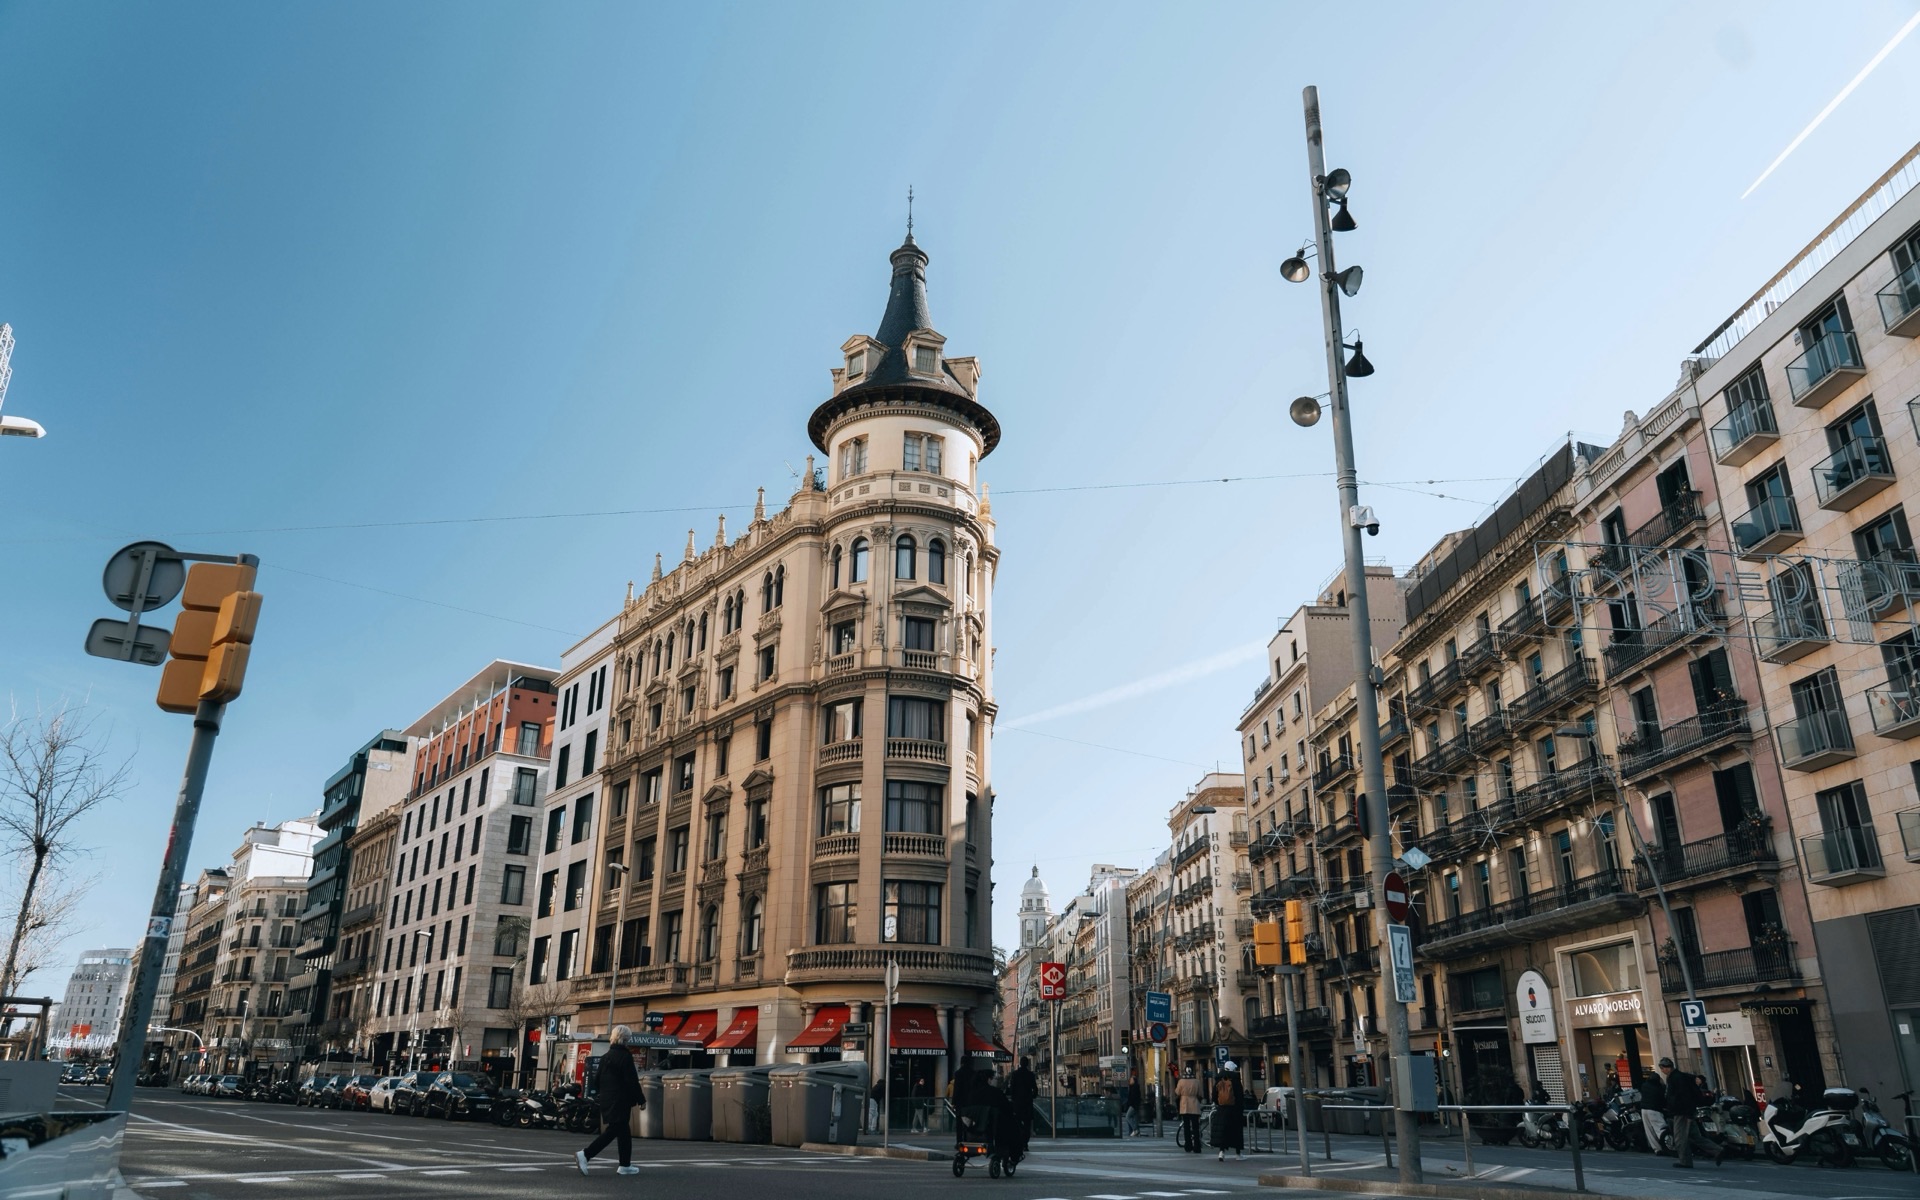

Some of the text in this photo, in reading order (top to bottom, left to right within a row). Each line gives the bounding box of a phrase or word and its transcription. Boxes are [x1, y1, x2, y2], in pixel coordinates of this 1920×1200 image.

[1211, 832, 1227, 988] HOTEL MIDMOST
[1050, 971, 1059, 980] M
[1575, 998, 1641, 1016] ALVARO MORENO
[1761, 1005, 1799, 1016] lemon
[1153, 1011, 1165, 1019] taxi
[1525, 1014, 1547, 1024] stucom
[1685, 1004, 1700, 1025] P
[549, 1018, 556, 1033] P
[1707, 1023, 1732, 1032] ORENCIA
[634, 1036, 676, 1046] VANGUARDIA
[901, 1048, 917, 1056] SALON
[917, 1048, 947, 1056] RECREATIVO
[1218, 1047, 1228, 1060] P
